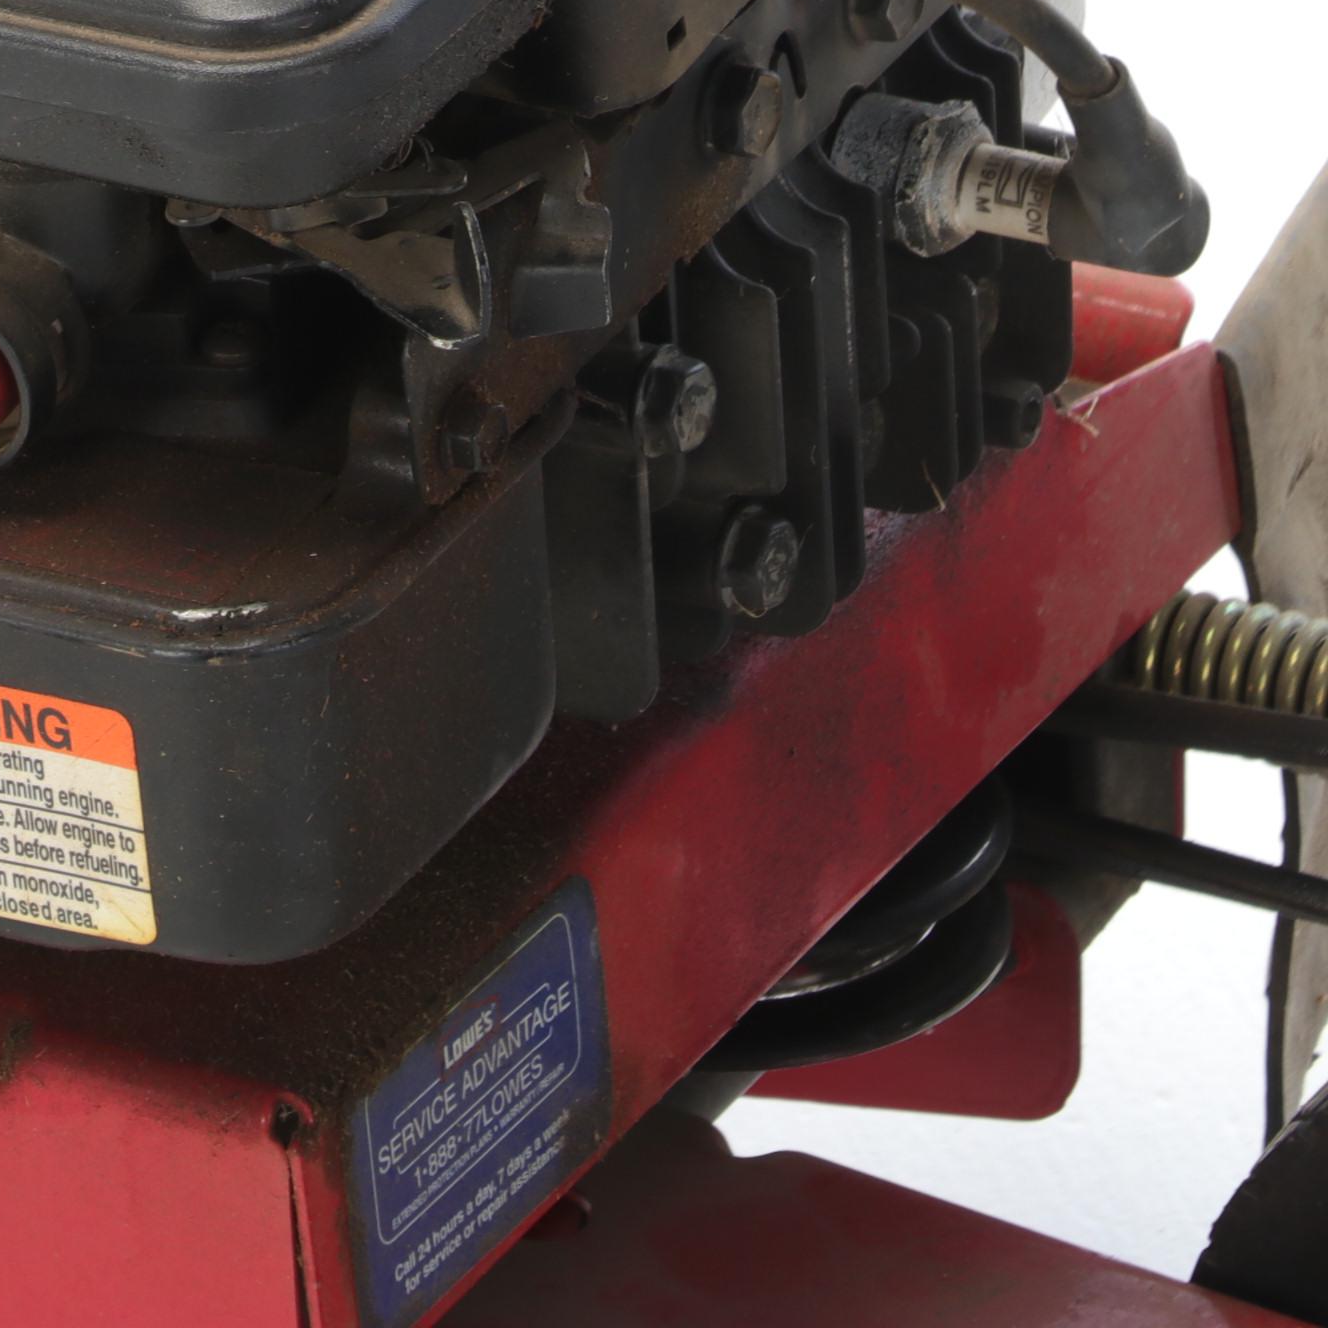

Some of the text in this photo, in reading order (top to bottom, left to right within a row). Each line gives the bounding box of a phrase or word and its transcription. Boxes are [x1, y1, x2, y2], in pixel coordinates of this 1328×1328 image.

[976, 158, 1001, 214] 19LM
[57, 789, 119, 818] engine.
[12, 807, 58, 836] Allow
[61, 821, 108, 848] engine
[109, 831, 136, 853] to
[12, 836, 65, 865] before
[68, 850, 144, 885] refueling.
[11, 872, 99, 906] monoxide,
[55, 906, 98, 929] area.
[443, 1008, 494, 1070] LOWE'S
[377, 980, 571, 1174] SERVICE ADVANTAGE
[469, 1128, 493, 1156] PLANS
[393, 1107, 570, 1282] Call 24 hours a day, 7 days a week
[404, 1270, 422, 1294] for
[422, 1233, 461, 1278] service
[462, 1219, 476, 1239] or
[476, 1188, 508, 1226] repair
